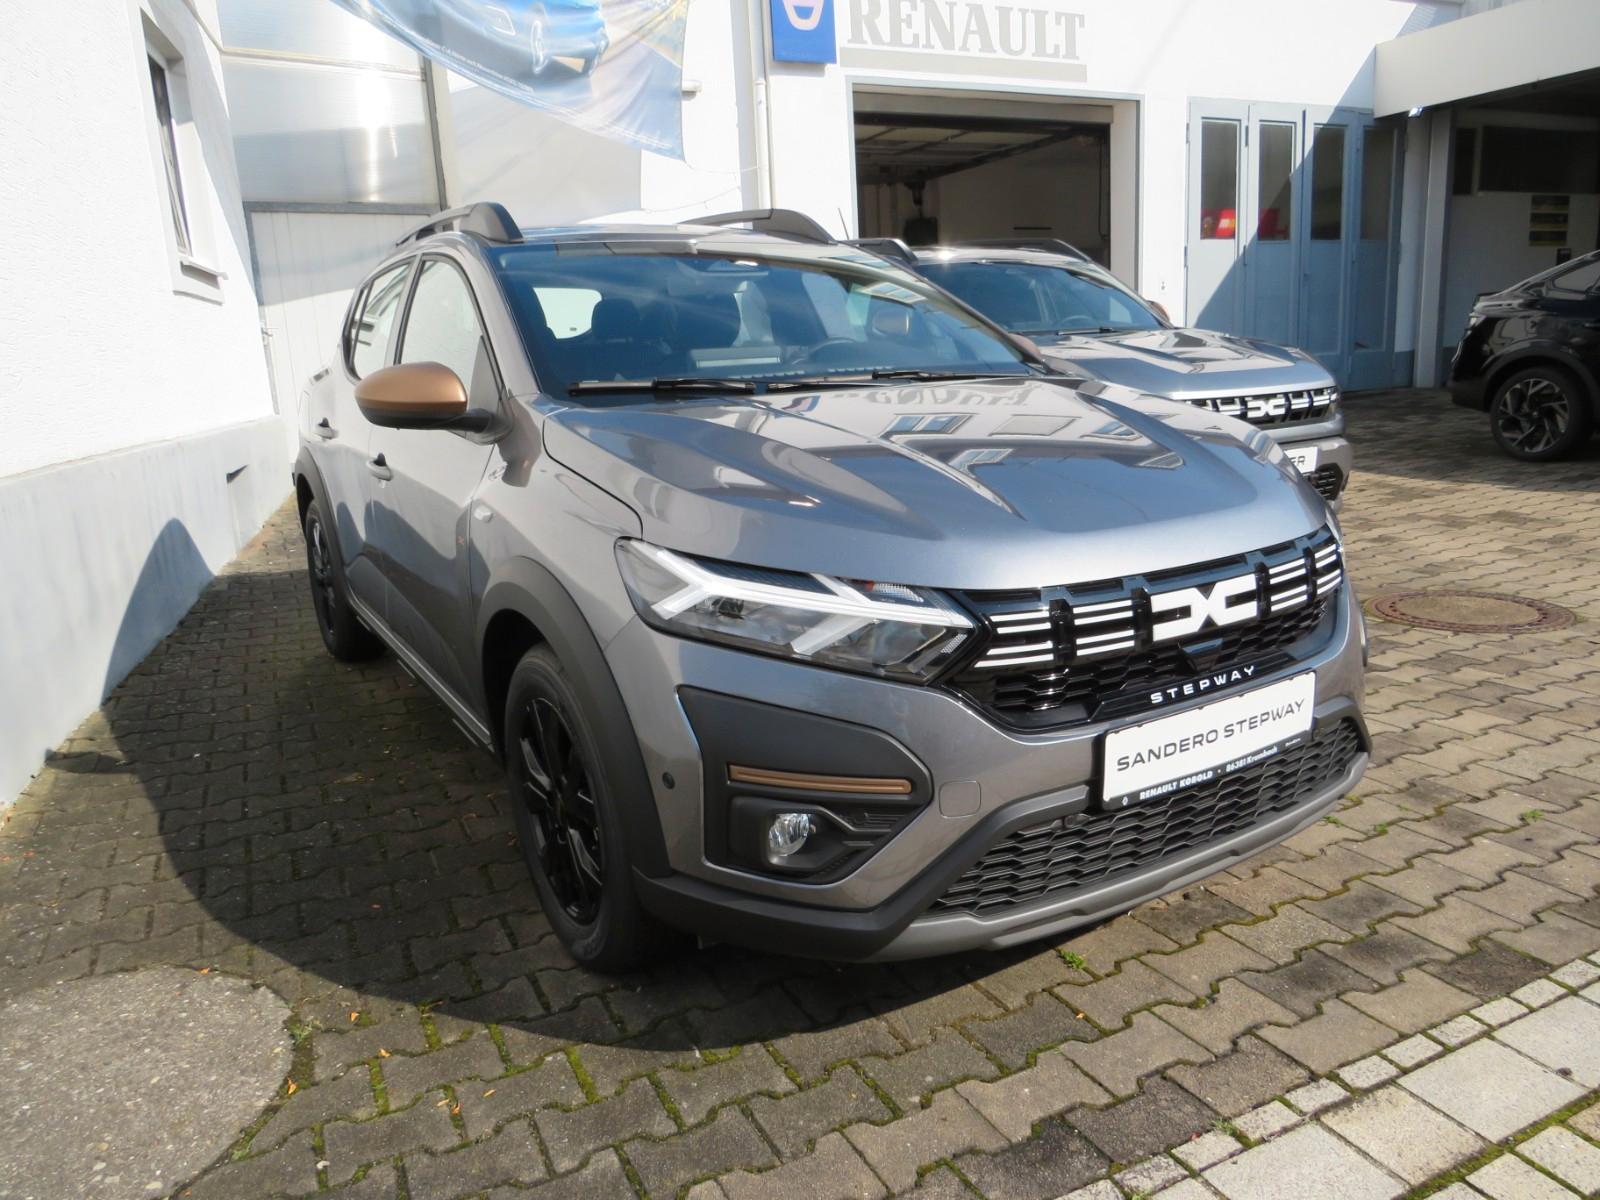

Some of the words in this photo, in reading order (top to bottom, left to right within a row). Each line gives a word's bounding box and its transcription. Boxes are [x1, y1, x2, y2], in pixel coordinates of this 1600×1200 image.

[847, 0, 1086, 60] RENAULT
[1150, 665, 1255, 704] STEPWAY
[1116, 728, 1219, 772] SANDERO
[1223, 698, 1305, 739] STEPWAY
[1139, 780, 1178, 801] RENAULT
[1179, 769, 1214, 789] KOBOLD
